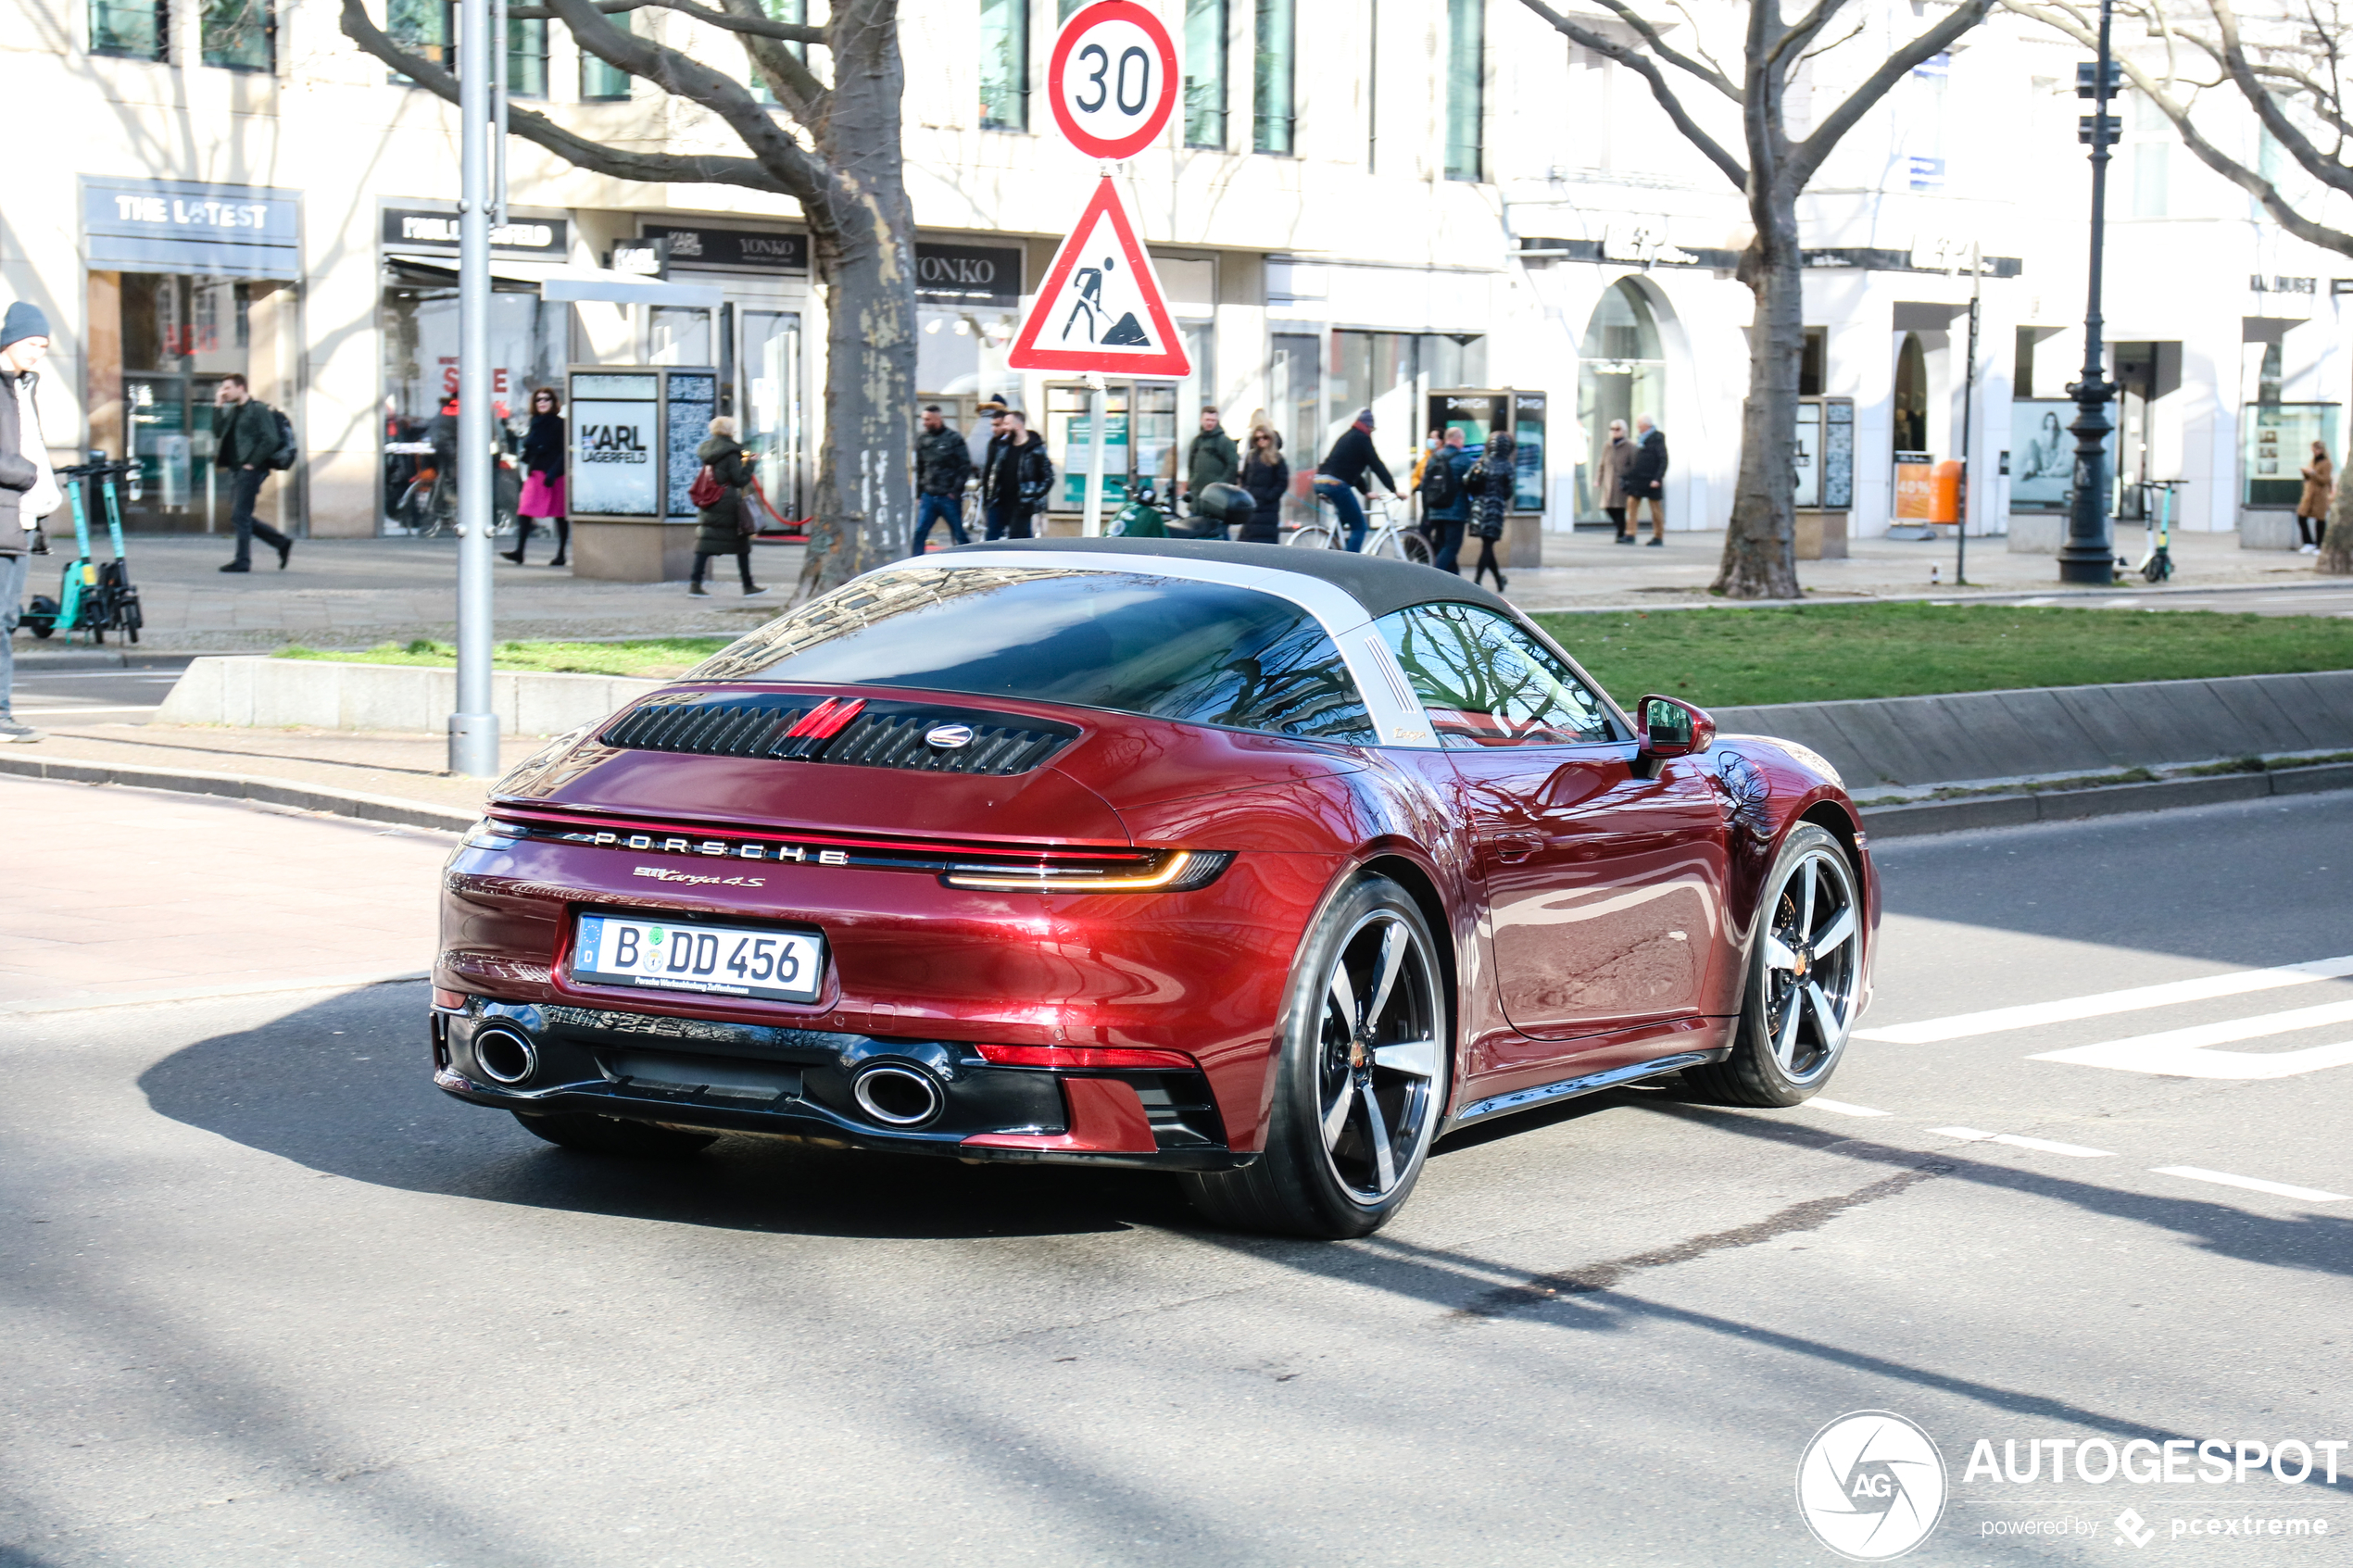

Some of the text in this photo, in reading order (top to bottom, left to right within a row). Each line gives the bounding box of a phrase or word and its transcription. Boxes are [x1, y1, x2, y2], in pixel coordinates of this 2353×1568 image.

[1076, 44, 1149, 116] 30
[115, 195, 268, 229] THE LATEST
[739, 238, 794, 255] YONKO
[160, 323, 219, 355] AEG
[443, 367, 508, 393] SE
[581, 424, 647, 451] KARL
[582, 451, 647, 464] LAGERFELD
[594, 832, 847, 866] PORSCHE
[584, 949, 593, 963] D
[615, 927, 640, 968] B
[666, 931, 719, 975] DD
[727, 937, 799, 983] 456
[635, 976, 749, 995] Porsche Werksabholung Zuffenhausen
